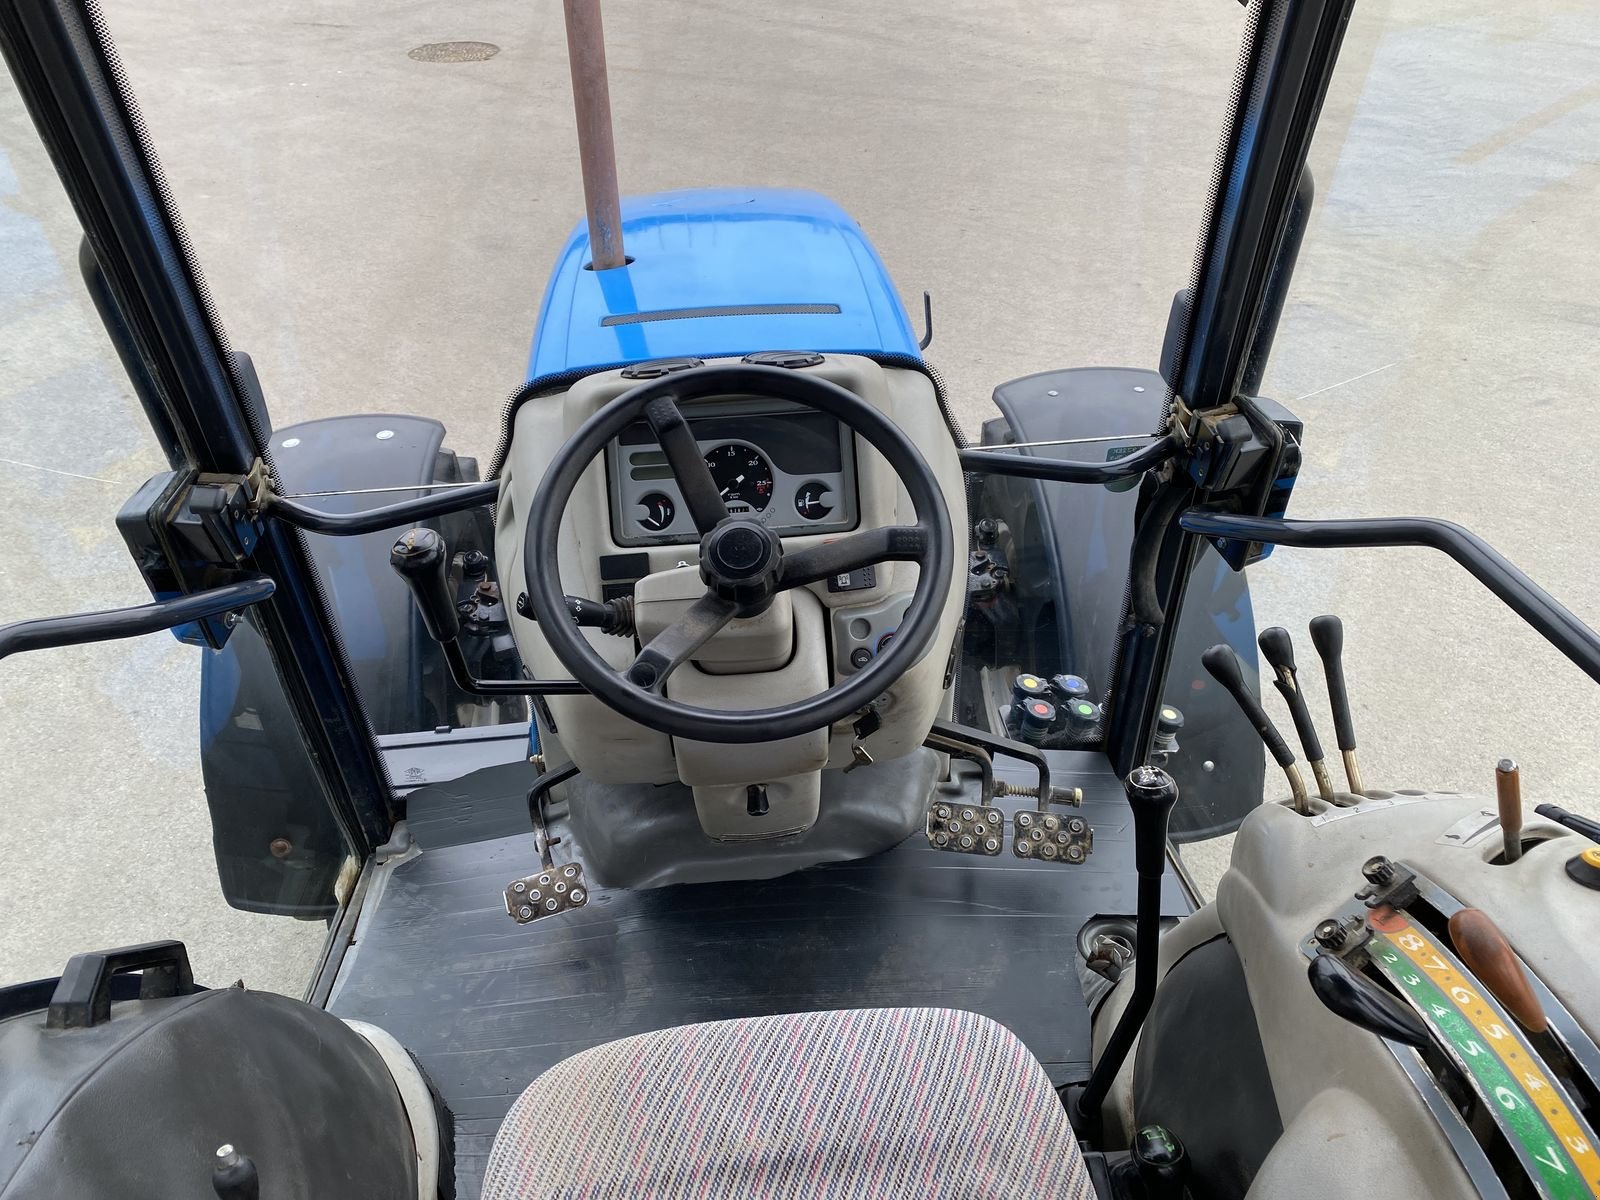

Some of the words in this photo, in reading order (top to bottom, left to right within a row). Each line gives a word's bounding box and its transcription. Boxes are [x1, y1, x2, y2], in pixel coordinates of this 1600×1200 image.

[1141, 774, 1150, 782] 2
[1352, 806, 1360, 814] 2
[1382, 952, 1398, 964] 2
[1402, 973, 1421, 986] 3
[1431, 1003, 1452, 1018] 4
[1457, 1040, 1486, 1057] 5
[1495, 1086, 1529, 1110] 6
[1535, 1145, 1568, 1175] 7
[1398, 933, 1425, 951] 8
[1423, 955, 1450, 970] 7
[1450, 986, 1481, 1004] 6
[1482, 1023, 1510, 1040] 5
[1523, 1072, 1549, 1091] 4
[1565, 1135, 1590, 1154] 3
